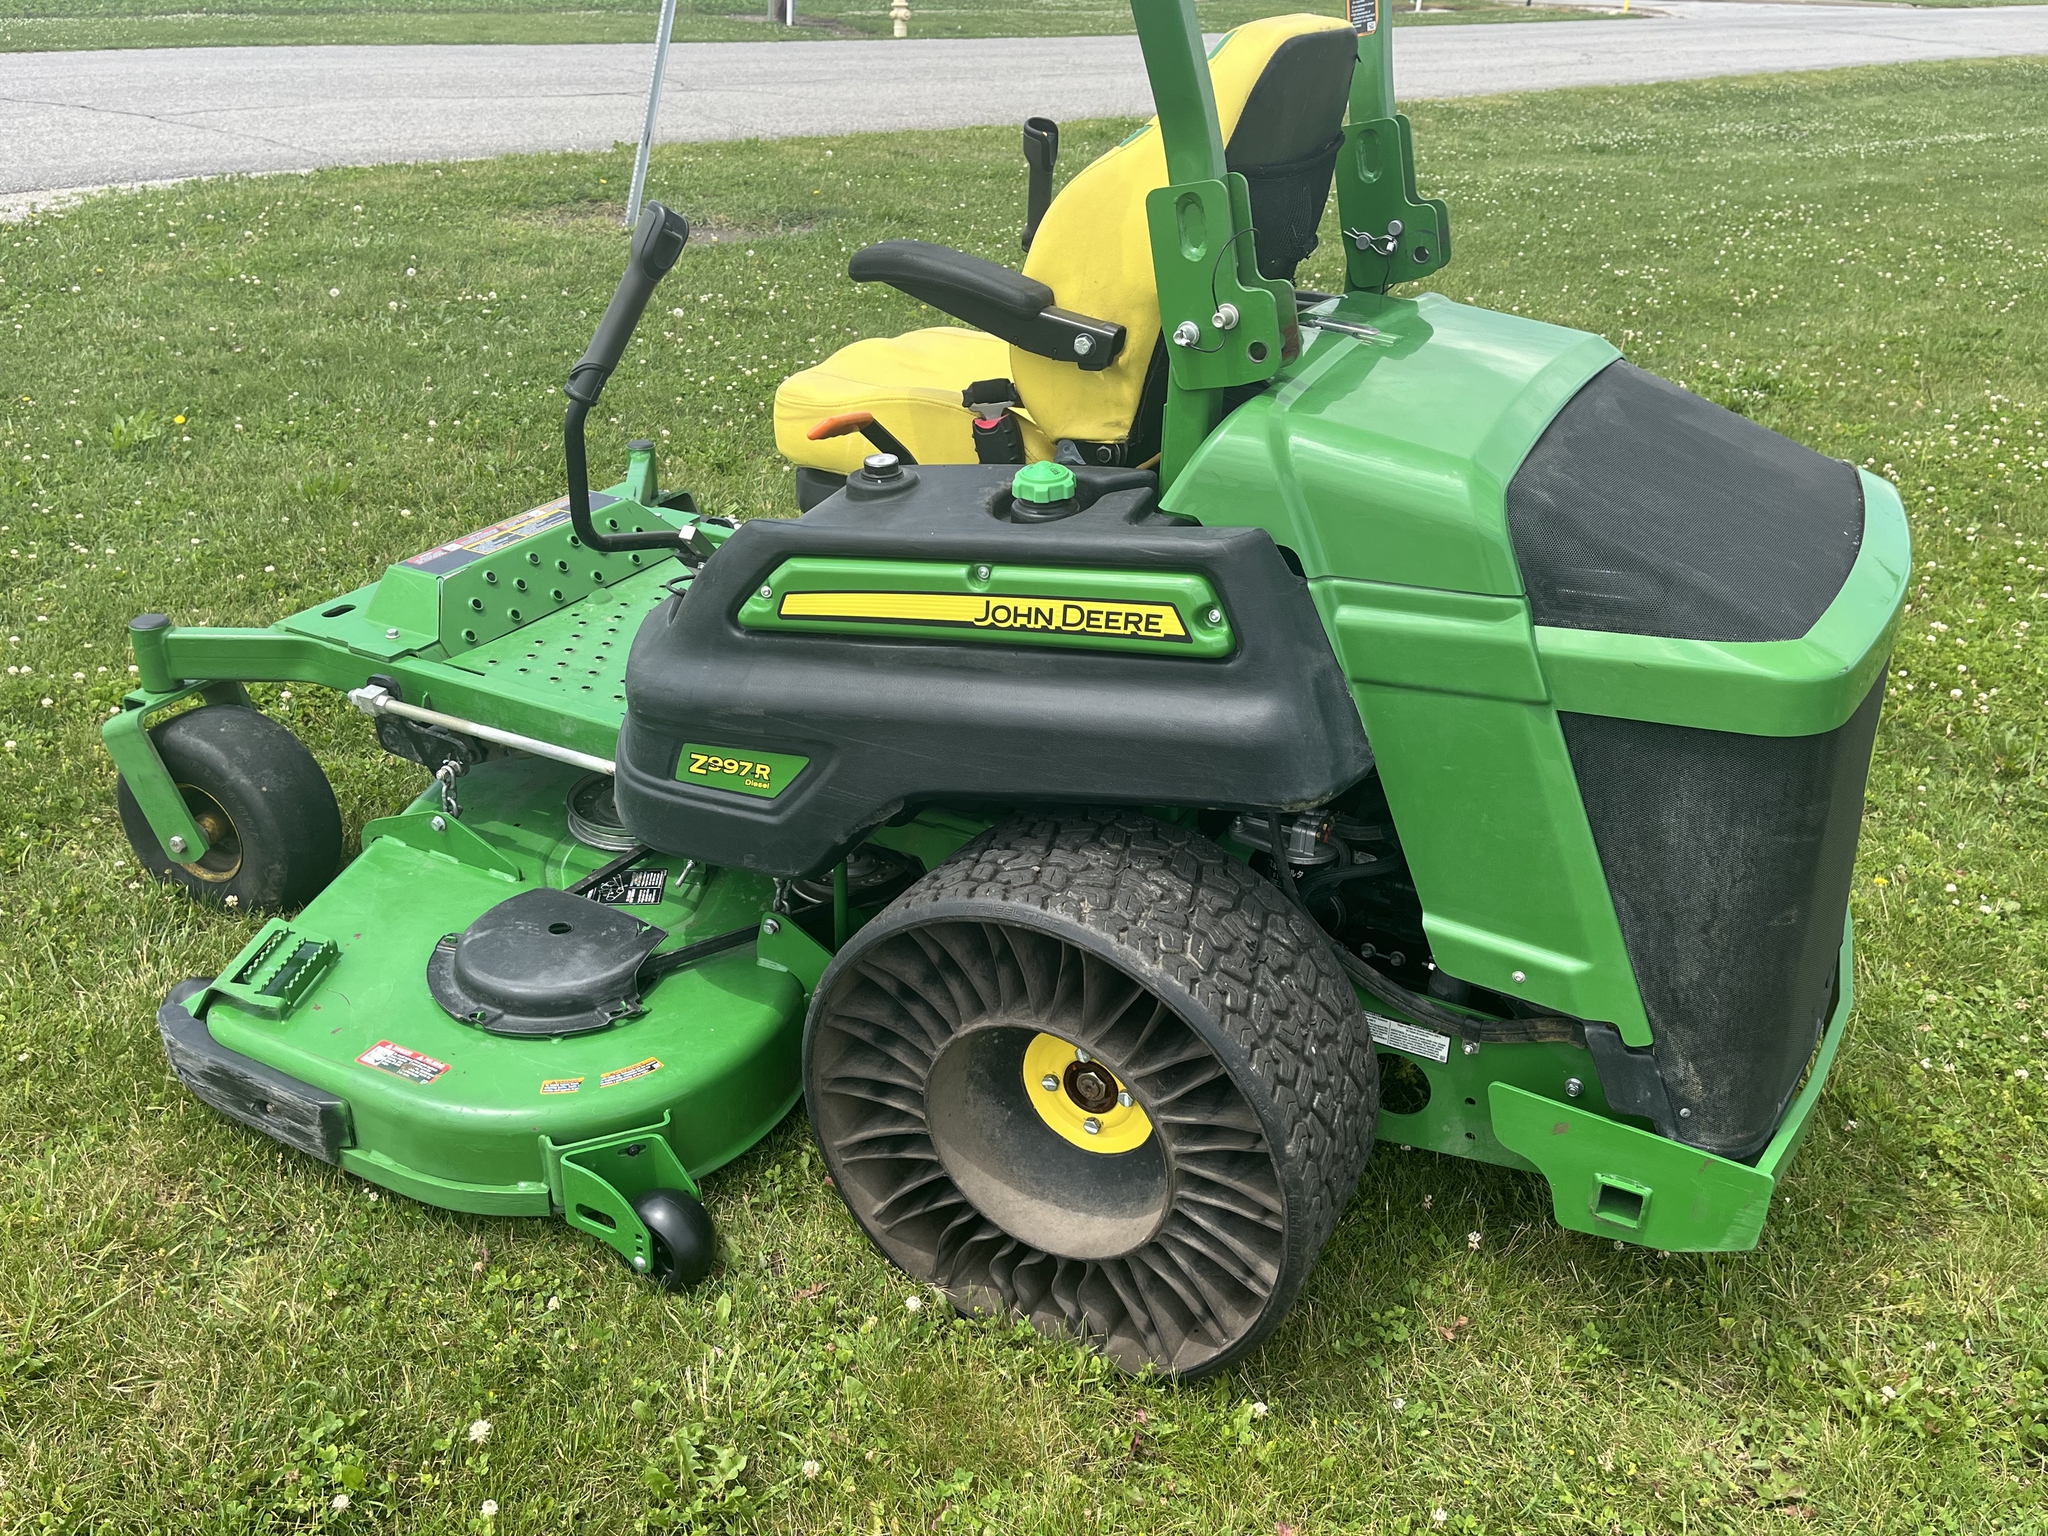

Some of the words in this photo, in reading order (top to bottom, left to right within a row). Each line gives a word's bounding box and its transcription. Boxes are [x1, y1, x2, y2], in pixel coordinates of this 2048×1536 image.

[974, 600, 1054, 626] JOHN
[1061, 604, 1163, 633] DEERE
[688, 752, 772, 780] Z997R
[744, 779, 770, 789] Diesel
